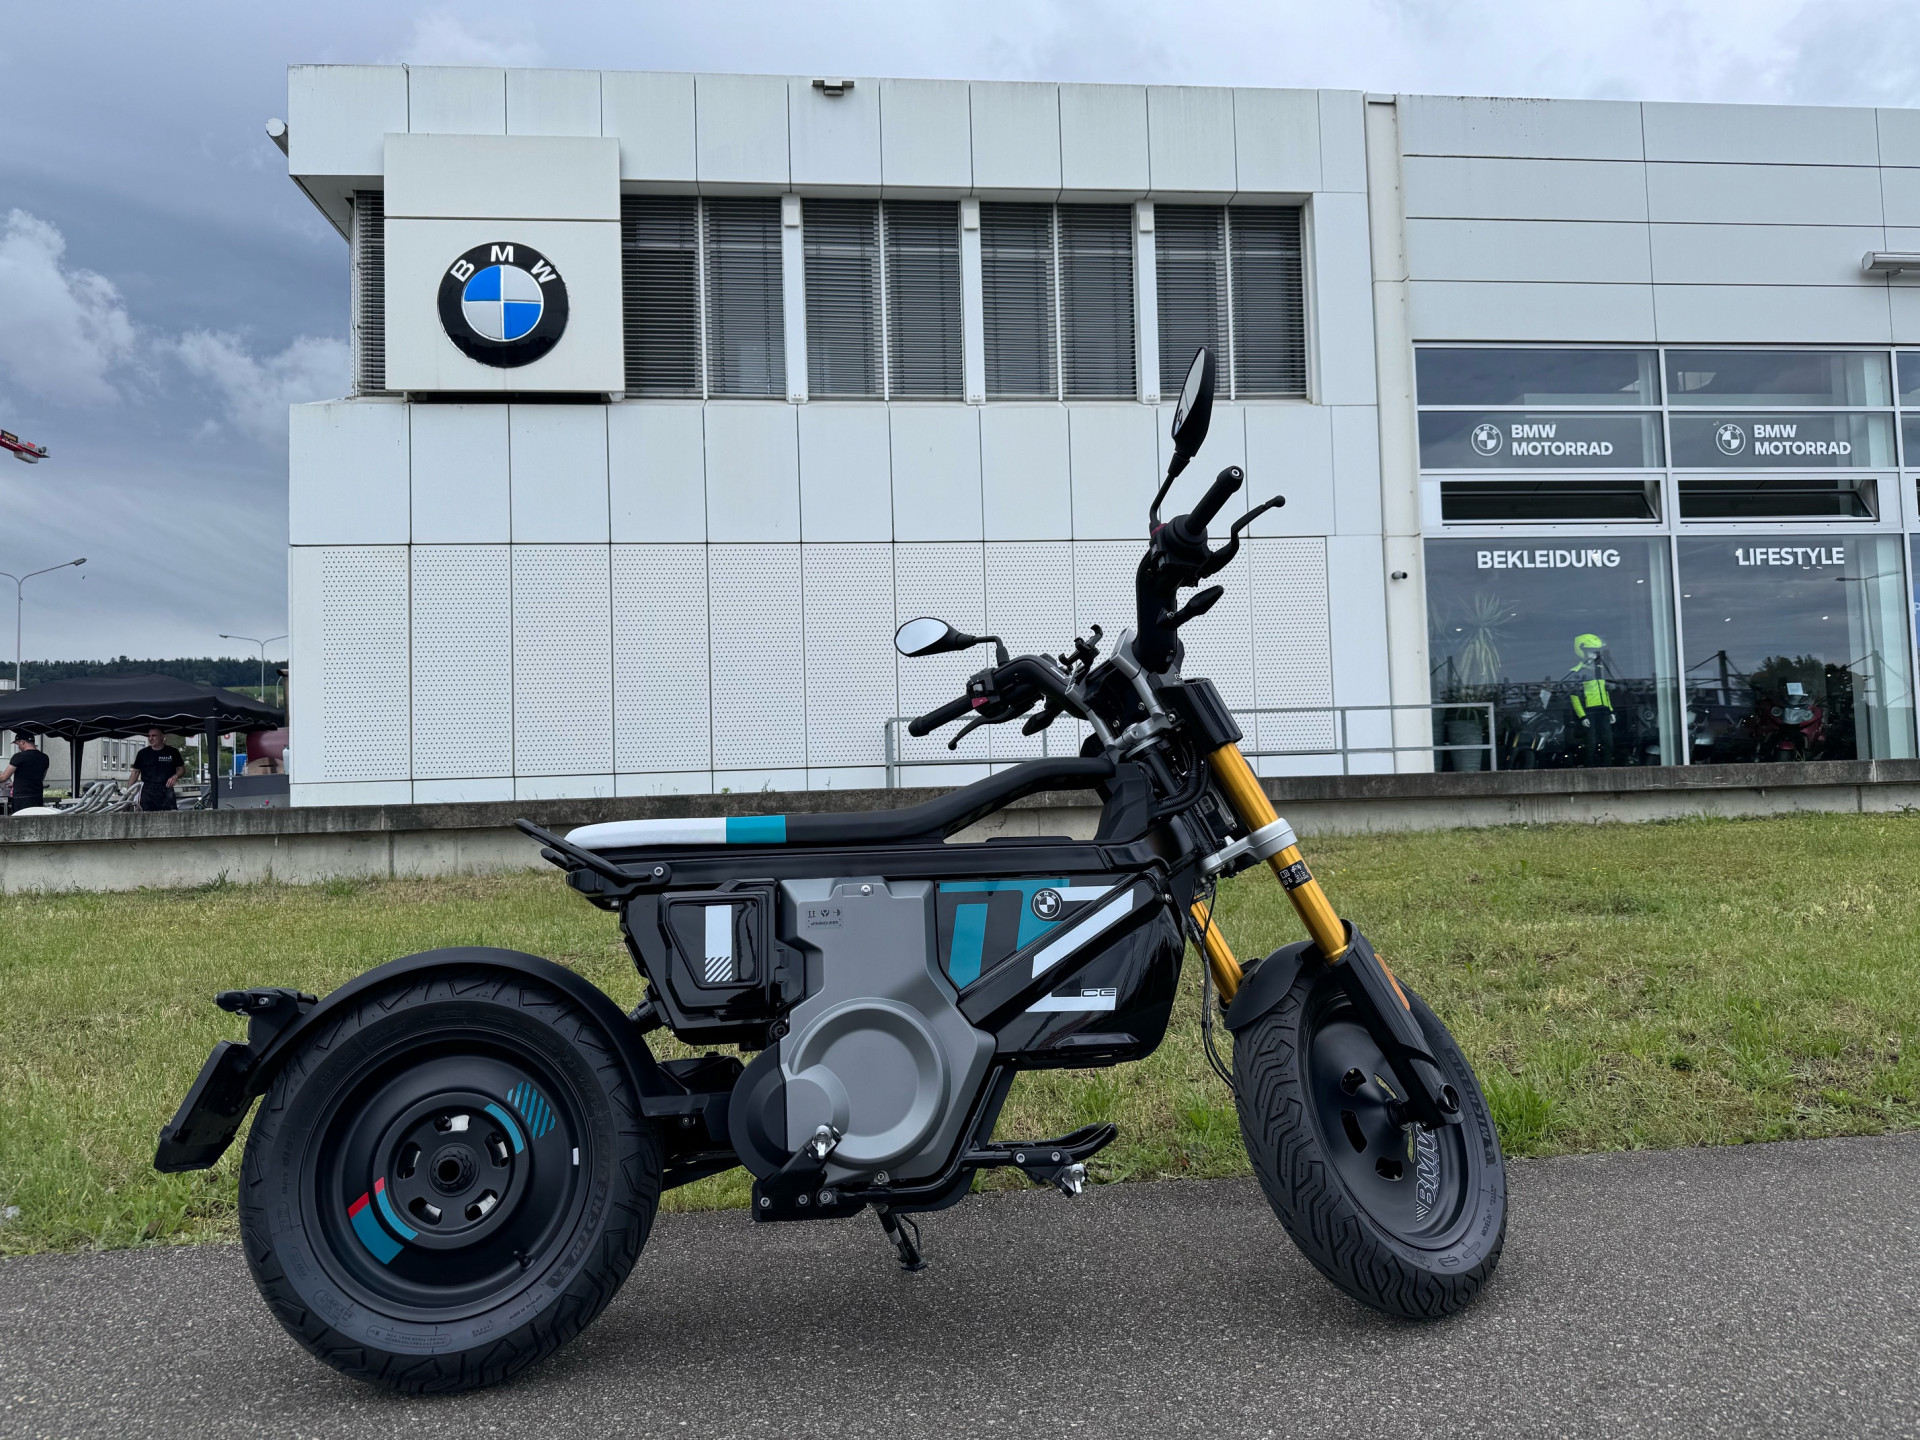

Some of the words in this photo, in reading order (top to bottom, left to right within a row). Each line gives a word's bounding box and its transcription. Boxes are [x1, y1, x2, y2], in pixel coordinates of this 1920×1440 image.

[450, 245, 557, 283] BMW
[1511, 424, 1556, 438] BMW
[1753, 424, 1797, 438] BMW
[1511, 441, 1614, 456] MOTORRAD
[1754, 441, 1851, 455] MOTORRAD
[1476, 549, 1621, 569] BEKLEIDUNG
[1738, 547, 1845, 566] LIFESTYLE
[1449, 1052, 1491, 1141] MICHELIN
